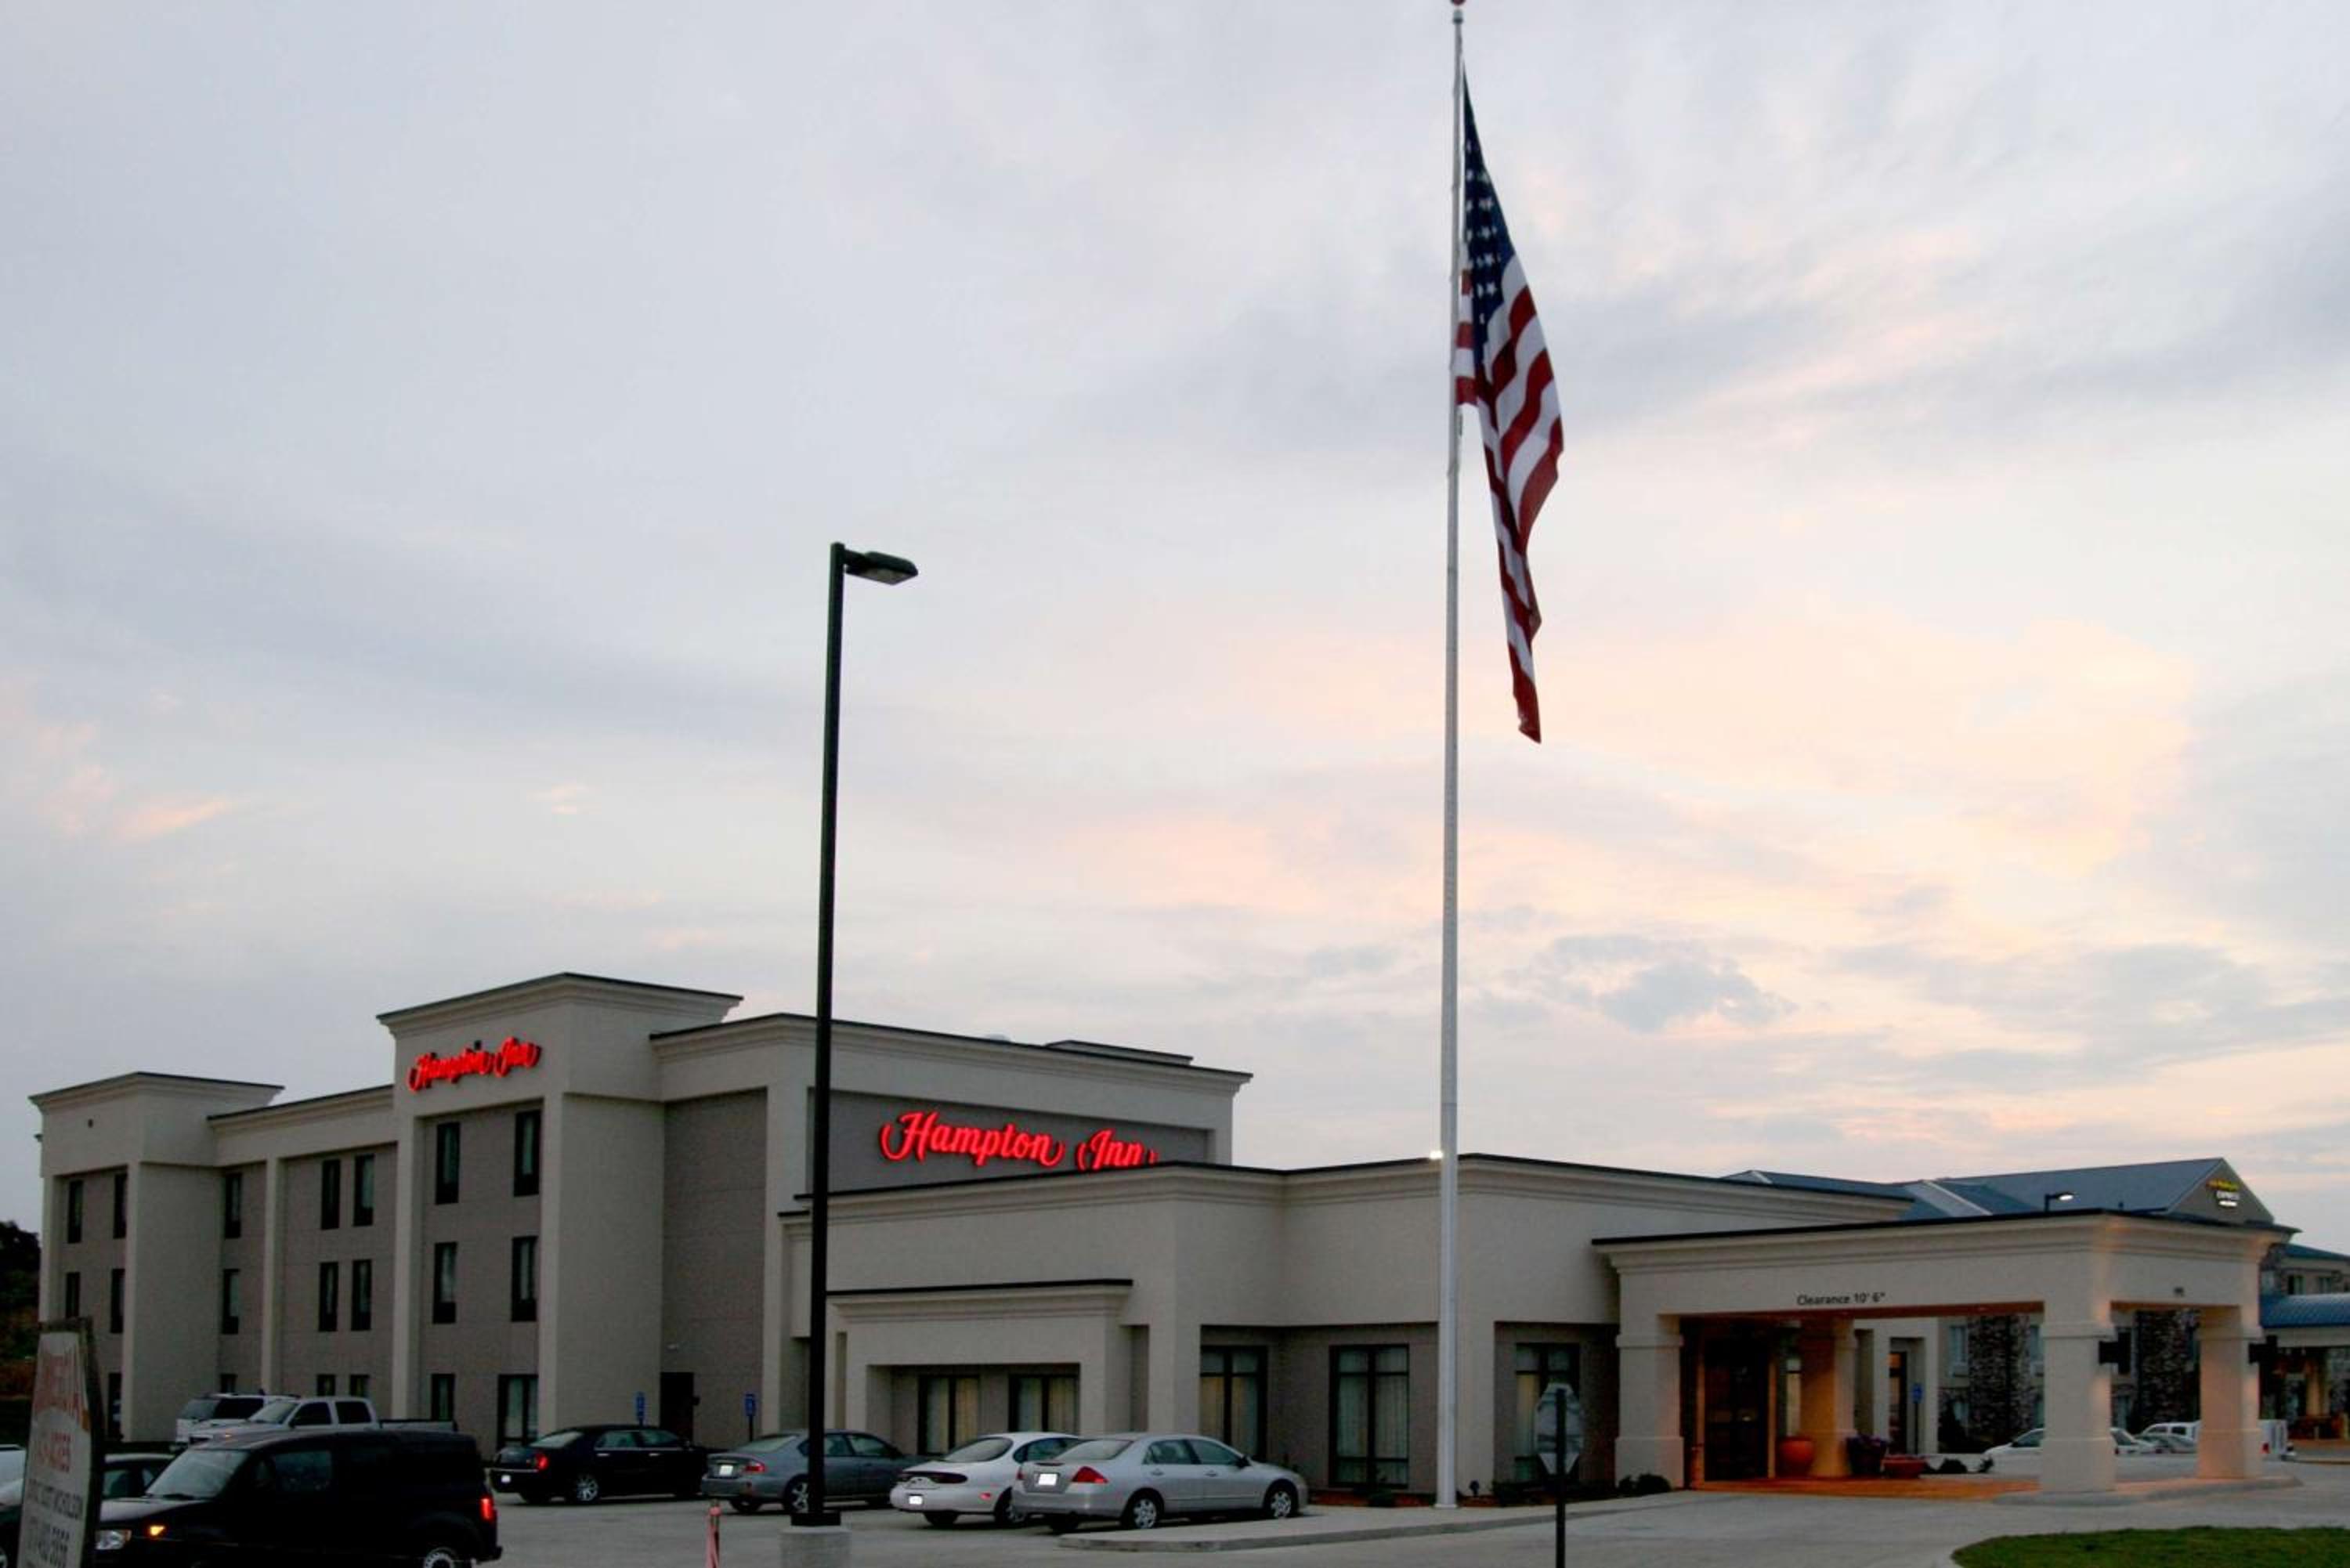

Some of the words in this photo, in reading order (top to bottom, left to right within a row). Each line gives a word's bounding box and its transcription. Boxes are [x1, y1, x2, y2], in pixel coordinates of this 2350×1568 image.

[494, 1036, 541, 1078] Inn
[879, 1111, 1065, 1167] Hampton
[1075, 1128, 1159, 1171] Inn
[1796, 1294, 1850, 1306] Clearance
